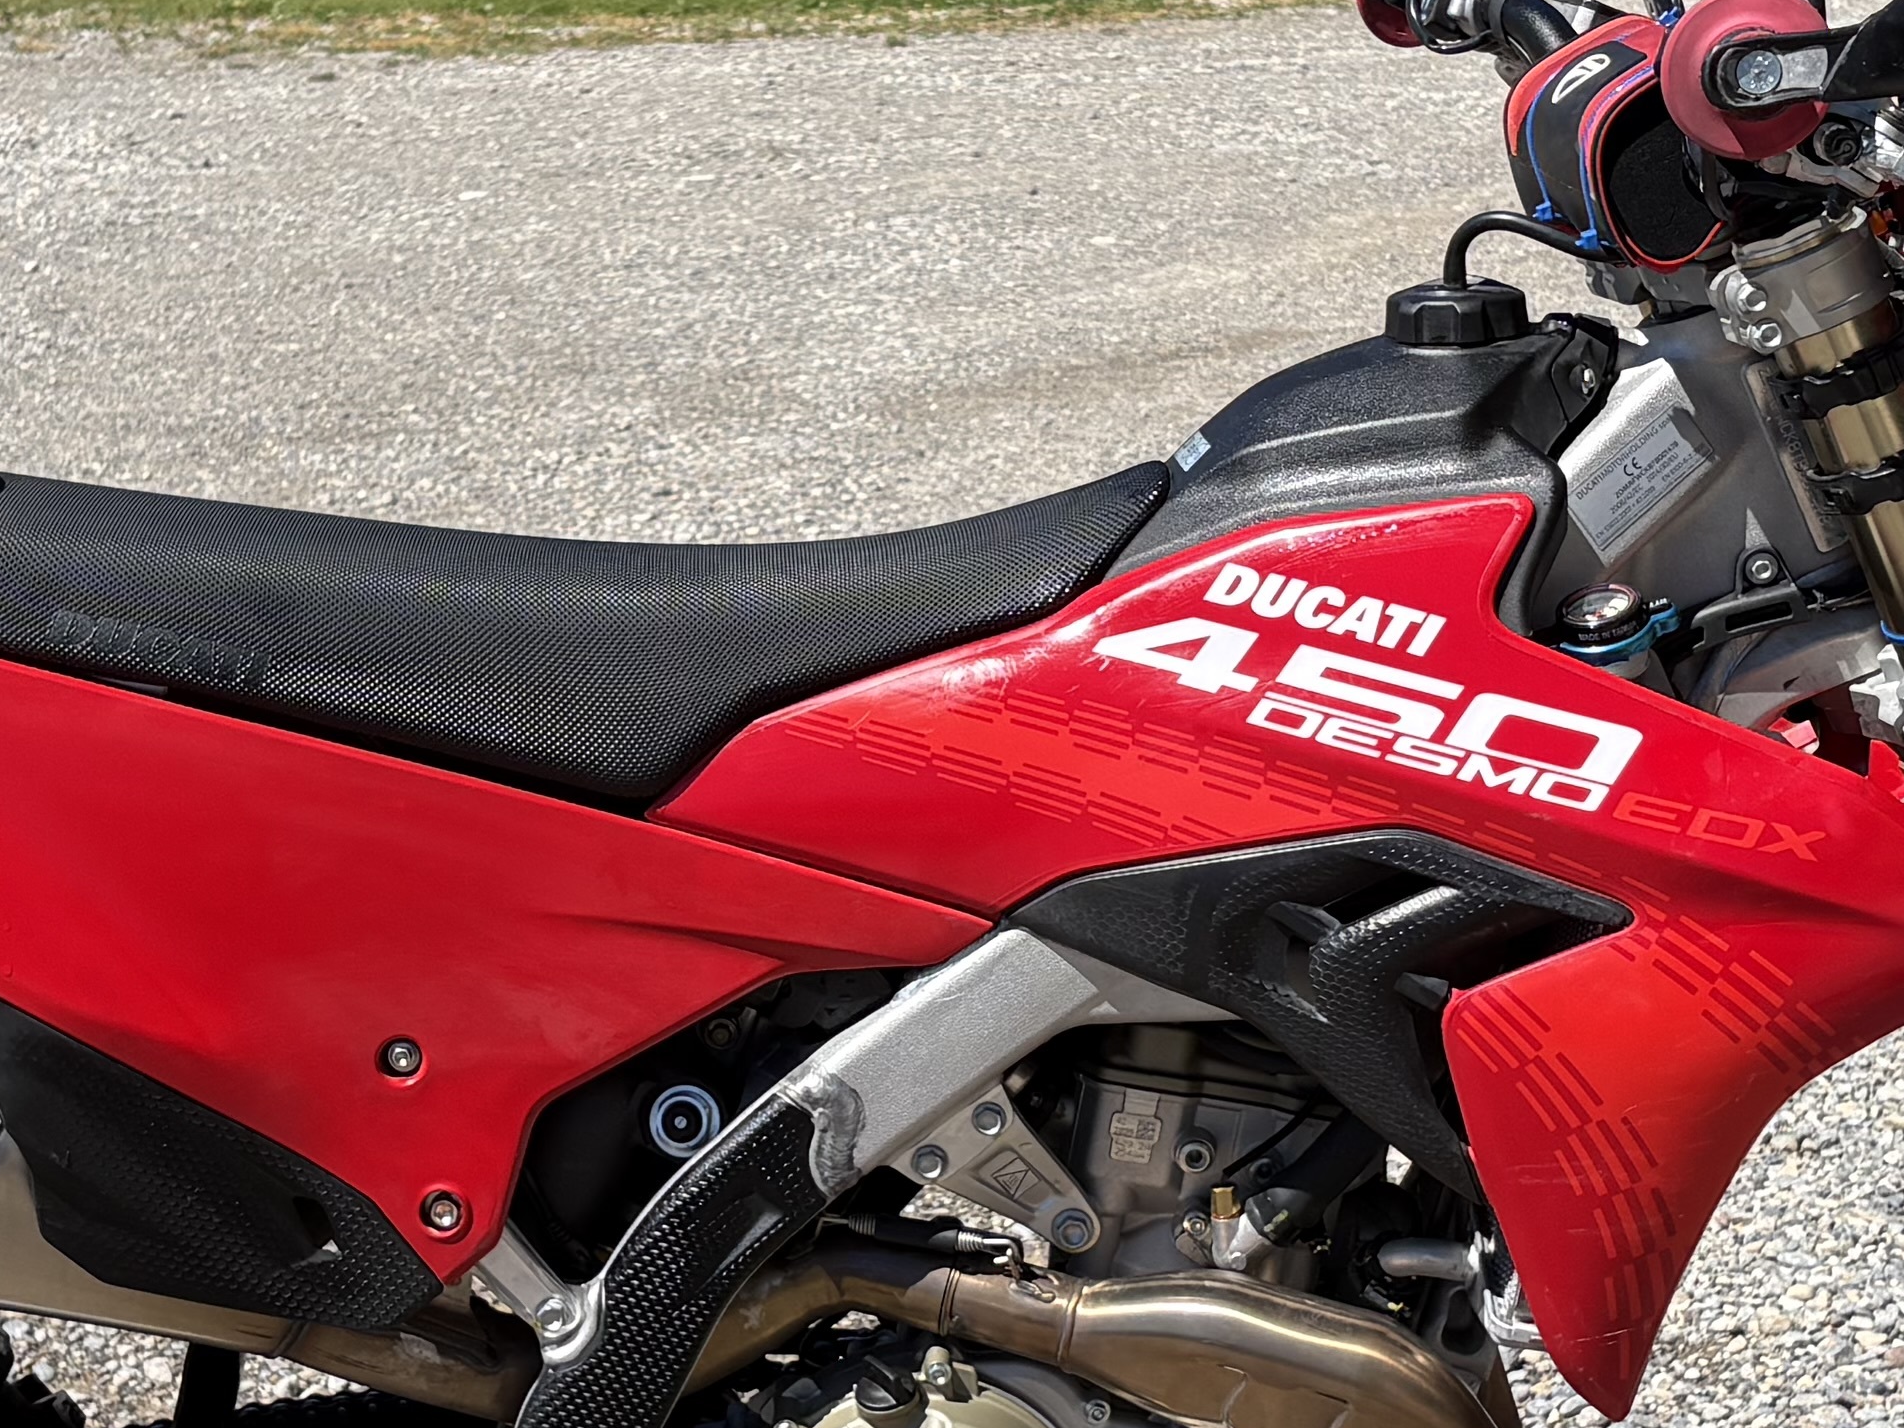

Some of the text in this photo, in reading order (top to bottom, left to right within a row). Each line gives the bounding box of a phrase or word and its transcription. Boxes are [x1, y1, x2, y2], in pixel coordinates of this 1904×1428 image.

[47, 609, 272, 689] DUCATI
[1203, 563, 1446, 657] DUCATI
[1092, 616, 1643, 786] 450
[1246, 690, 1612, 812] DESMO
[1611, 794, 1829, 862] EDX
